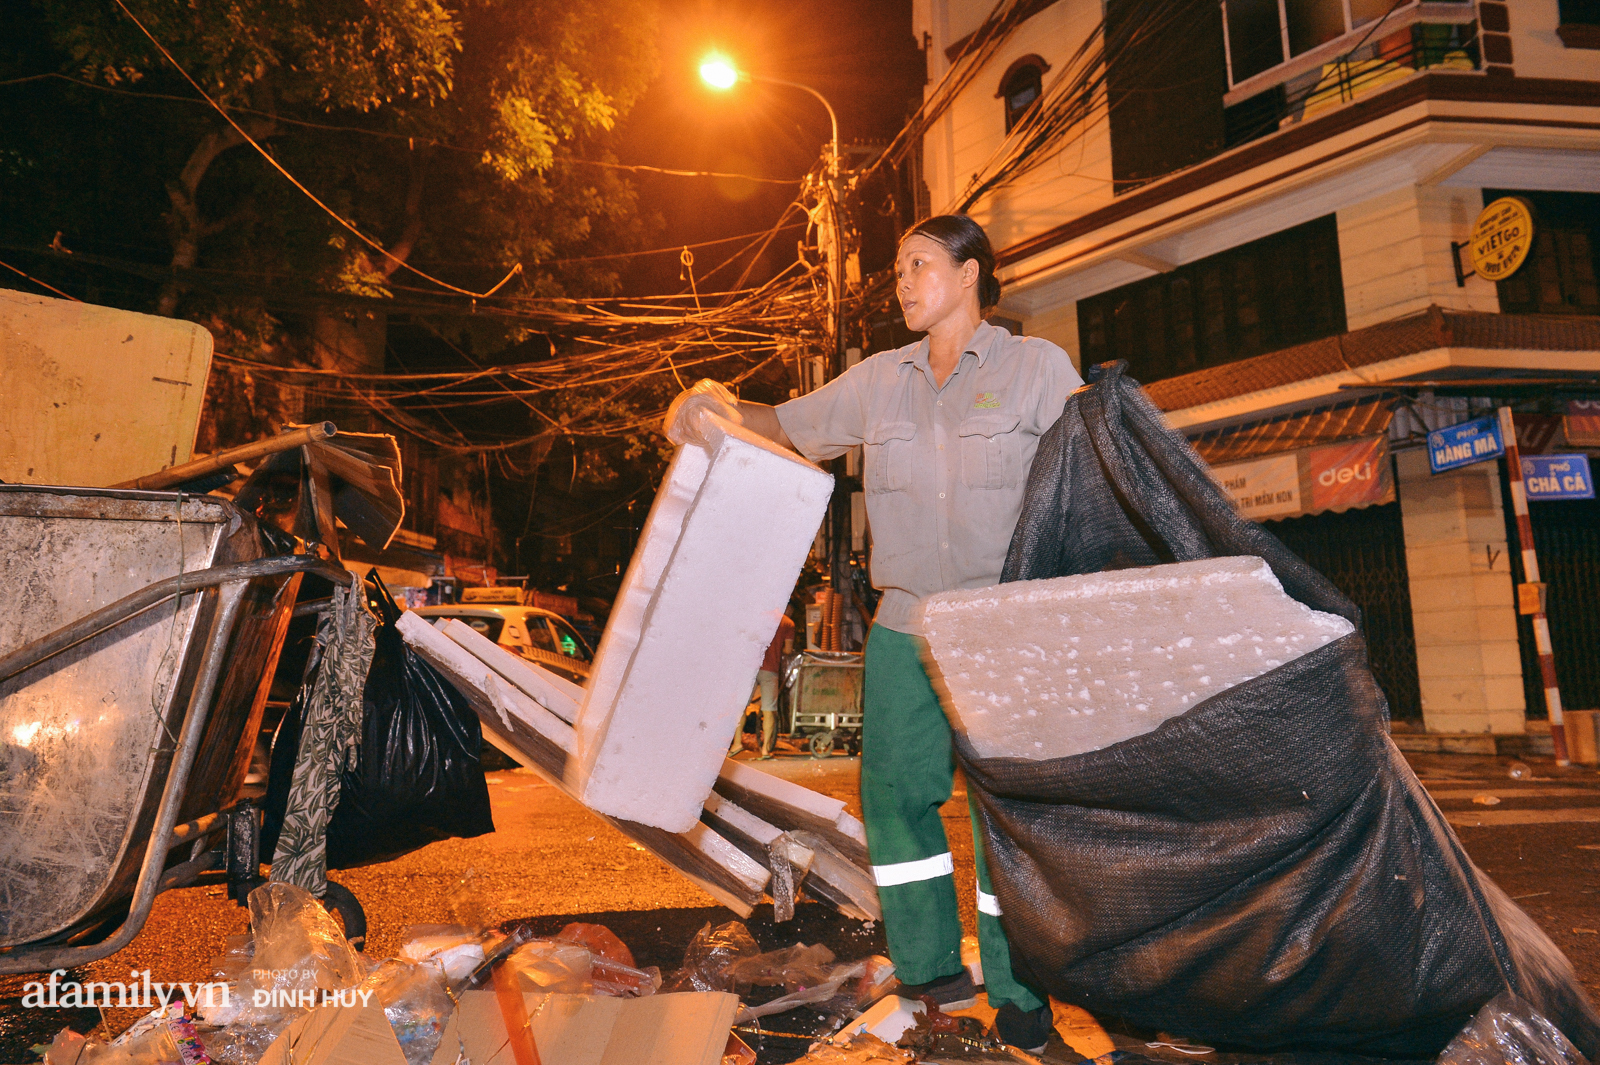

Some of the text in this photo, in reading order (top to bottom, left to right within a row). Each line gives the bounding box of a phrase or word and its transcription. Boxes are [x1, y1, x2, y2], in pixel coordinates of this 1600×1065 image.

[1478, 227, 1520, 255] VIETGO
[1436, 443, 1472, 465] HÀNG
[1318, 461, 1372, 487] deli
[1528, 471, 1587, 493] CHẢ CÁ
